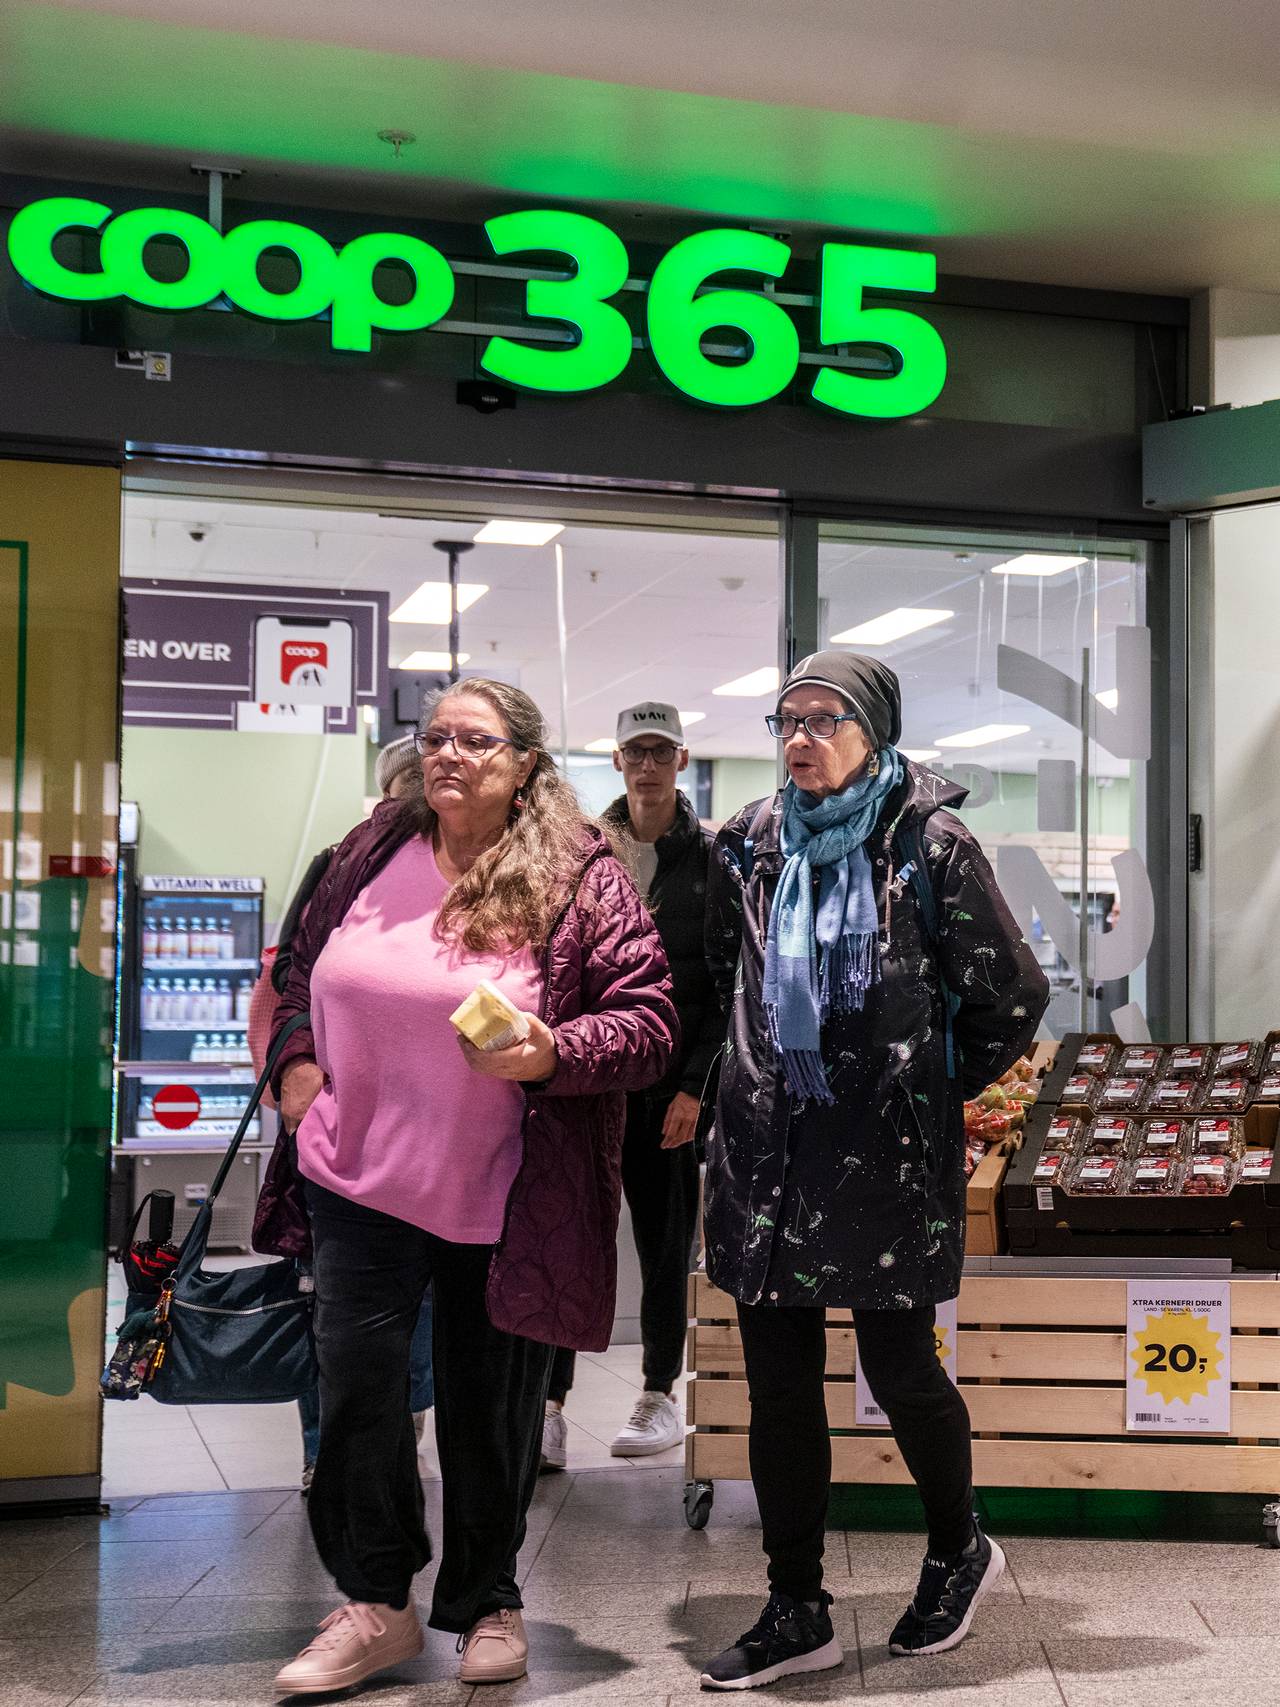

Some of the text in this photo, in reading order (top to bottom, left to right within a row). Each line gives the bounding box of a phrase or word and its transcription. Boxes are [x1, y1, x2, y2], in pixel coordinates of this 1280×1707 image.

[8, 198, 947, 418] coop 365
[162, 640, 231, 662] OVER
[285, 646, 319, 658] coop
[152, 878, 255, 891] VITAMIN WELL
